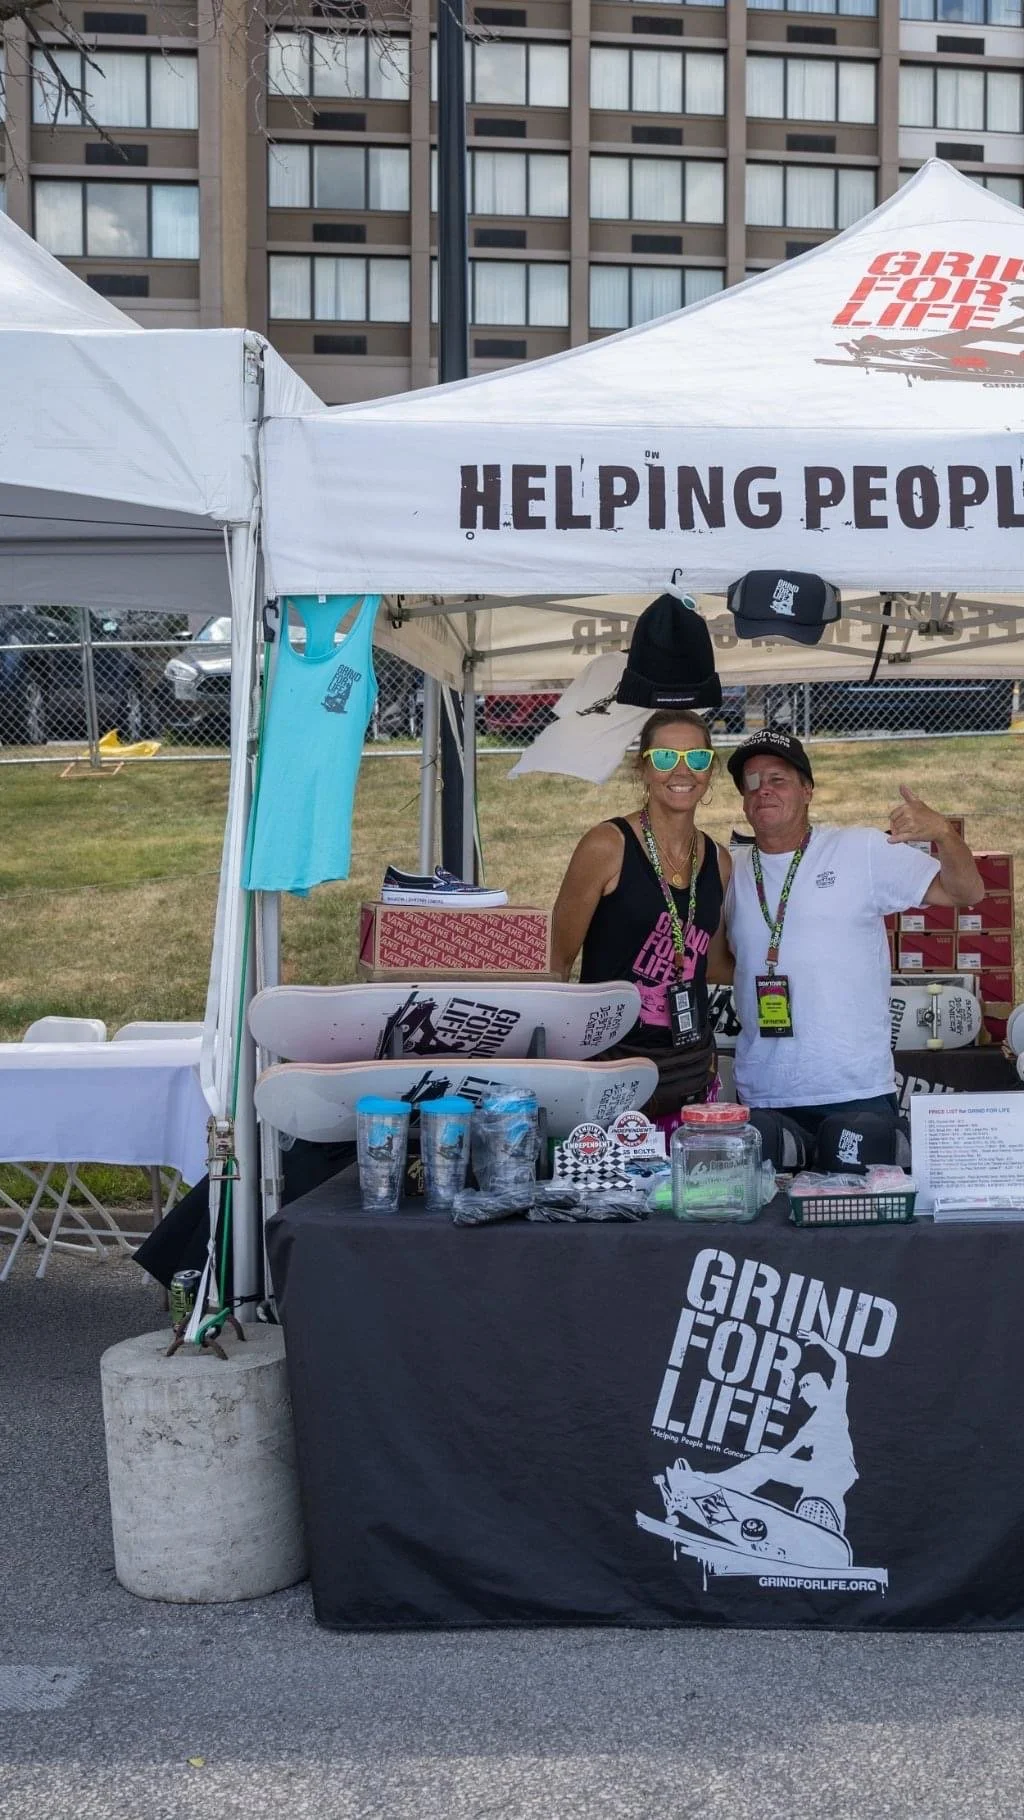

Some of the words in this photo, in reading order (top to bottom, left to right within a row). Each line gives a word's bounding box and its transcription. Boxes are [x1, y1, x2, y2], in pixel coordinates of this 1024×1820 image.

[848, 276, 1008, 305] FOR
[832, 303, 1001, 331] LIFE
[460, 463, 783, 531] HELPING
[338, 664, 362, 682] GRIND
[655, 911, 711, 955] GND
[436, 997, 477, 1040] LIFE
[456, 1002, 500, 1043] FOR
[567, 1141, 611, 1149] INDEPENDENT
[686, 1248, 898, 1358] GRIND
[668, 1307, 802, 1399] FOR
[651, 1369, 791, 1454] LIFE
[681, 1436, 704, 1448] People
[705, 1444, 721, 1453] with
[758, 1577, 877, 1591] GRINDFORLIFE.ORG
